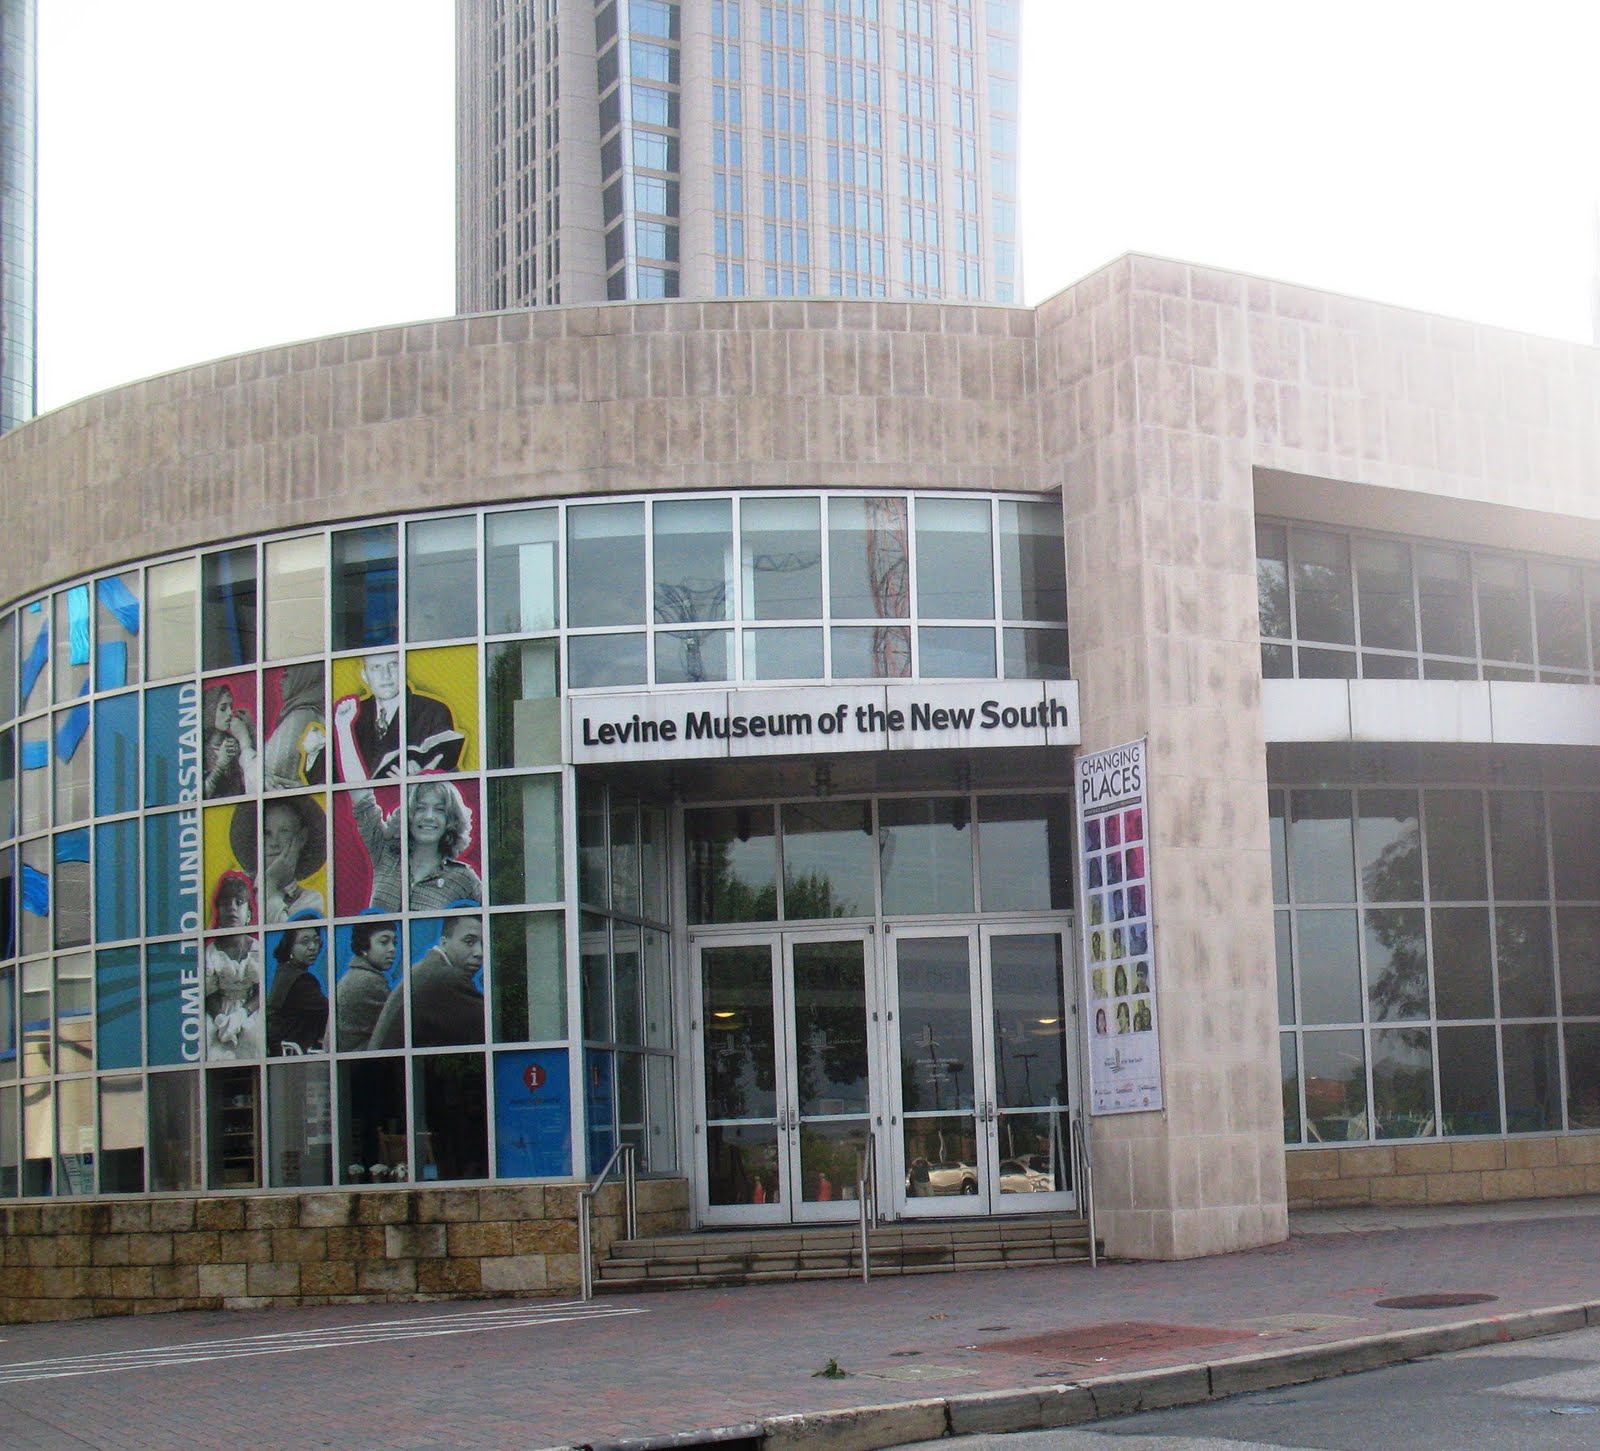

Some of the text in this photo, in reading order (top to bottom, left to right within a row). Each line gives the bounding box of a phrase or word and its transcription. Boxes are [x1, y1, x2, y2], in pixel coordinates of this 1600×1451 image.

[582, 698, 1069, 746] Levine Museum of the New South
[1081, 746, 1140, 776] CHANGING
[1082, 764, 1141, 804] PLACES
[178, 682, 200, 896] UNDERSTAND
[181, 967, 200, 1061] COME
